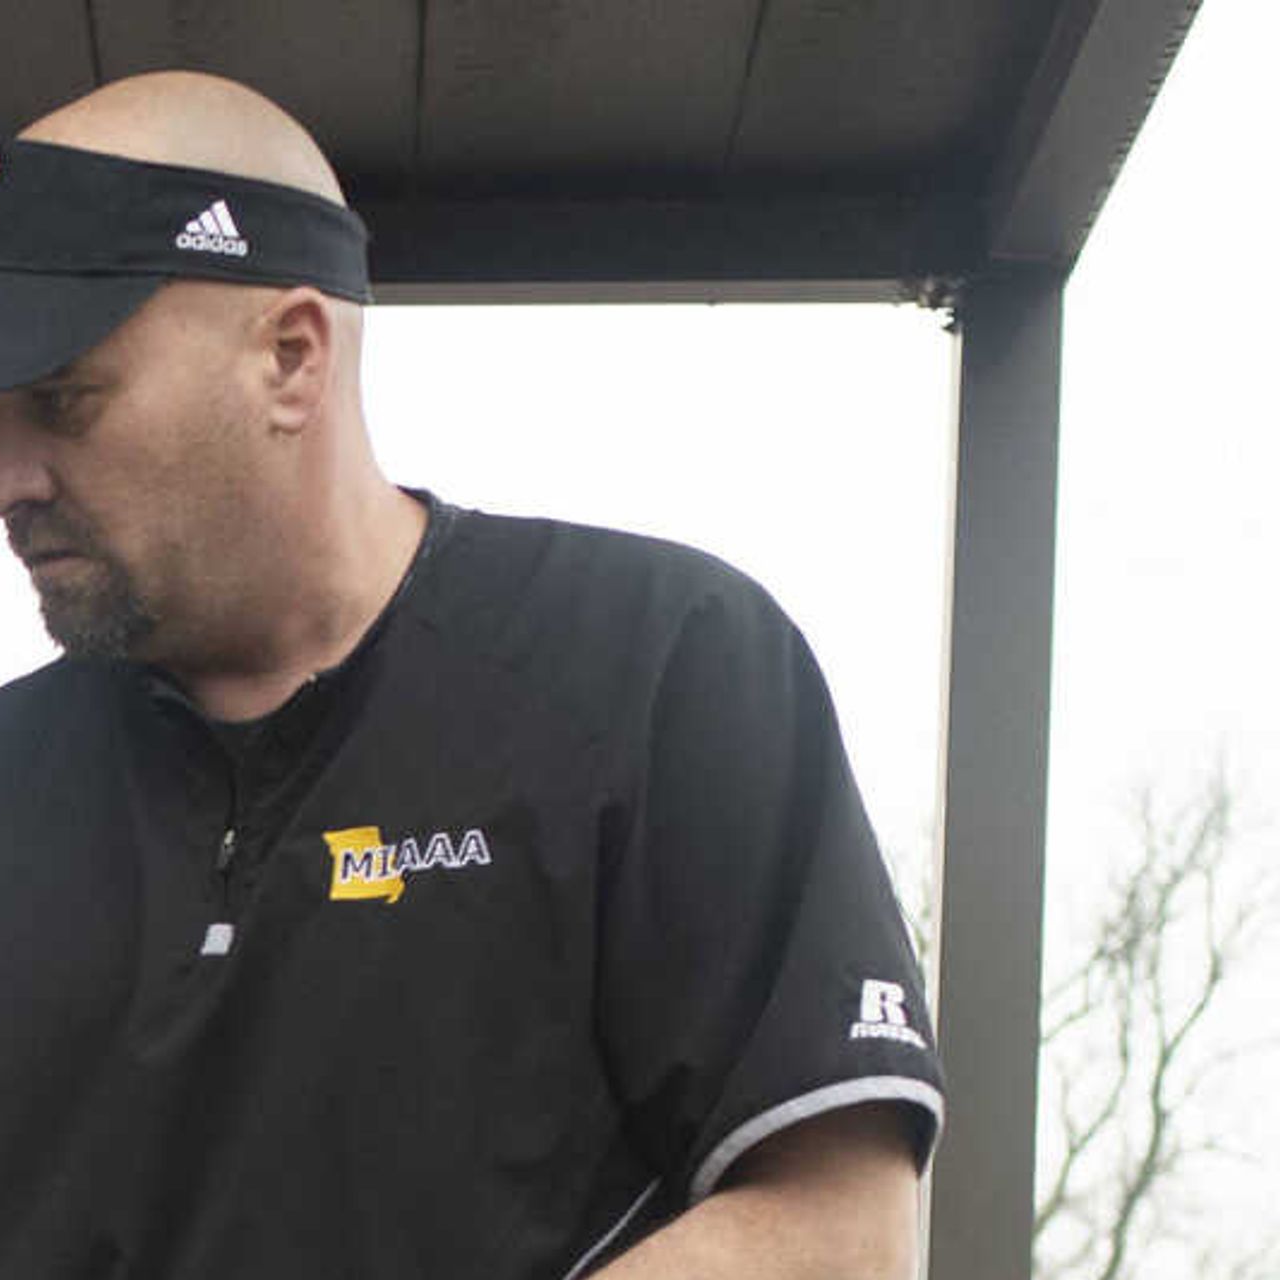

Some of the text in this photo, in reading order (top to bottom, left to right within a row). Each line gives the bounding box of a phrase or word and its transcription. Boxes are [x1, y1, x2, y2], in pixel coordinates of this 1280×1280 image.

[175, 227, 249, 257] adidas
[338, 829, 493, 884] MIAAA
[860, 979, 908, 1024] R
